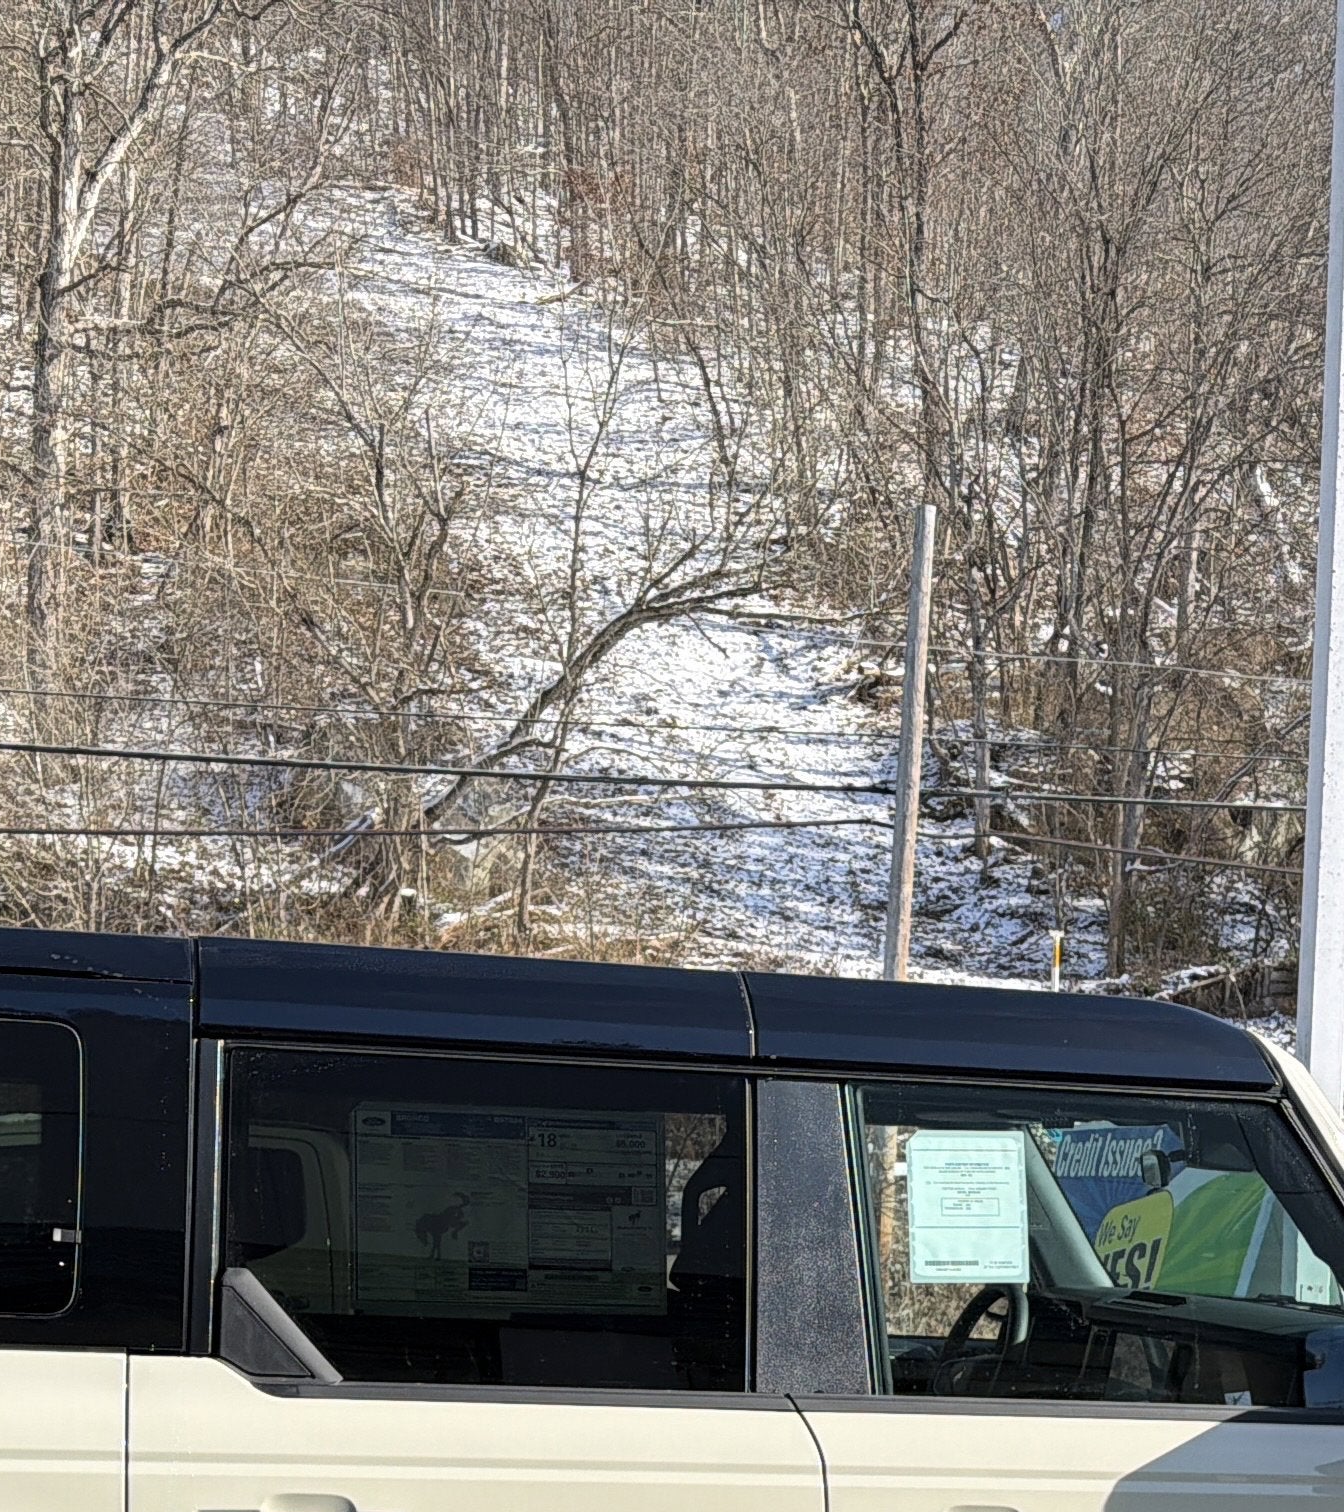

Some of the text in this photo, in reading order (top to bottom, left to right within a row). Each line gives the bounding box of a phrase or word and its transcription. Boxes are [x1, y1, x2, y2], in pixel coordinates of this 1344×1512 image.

[537, 1132, 557, 1147] 18
[1057, 1128, 1164, 1178] Credit Issue?
[1098, 1214, 1141, 1248] We Say
